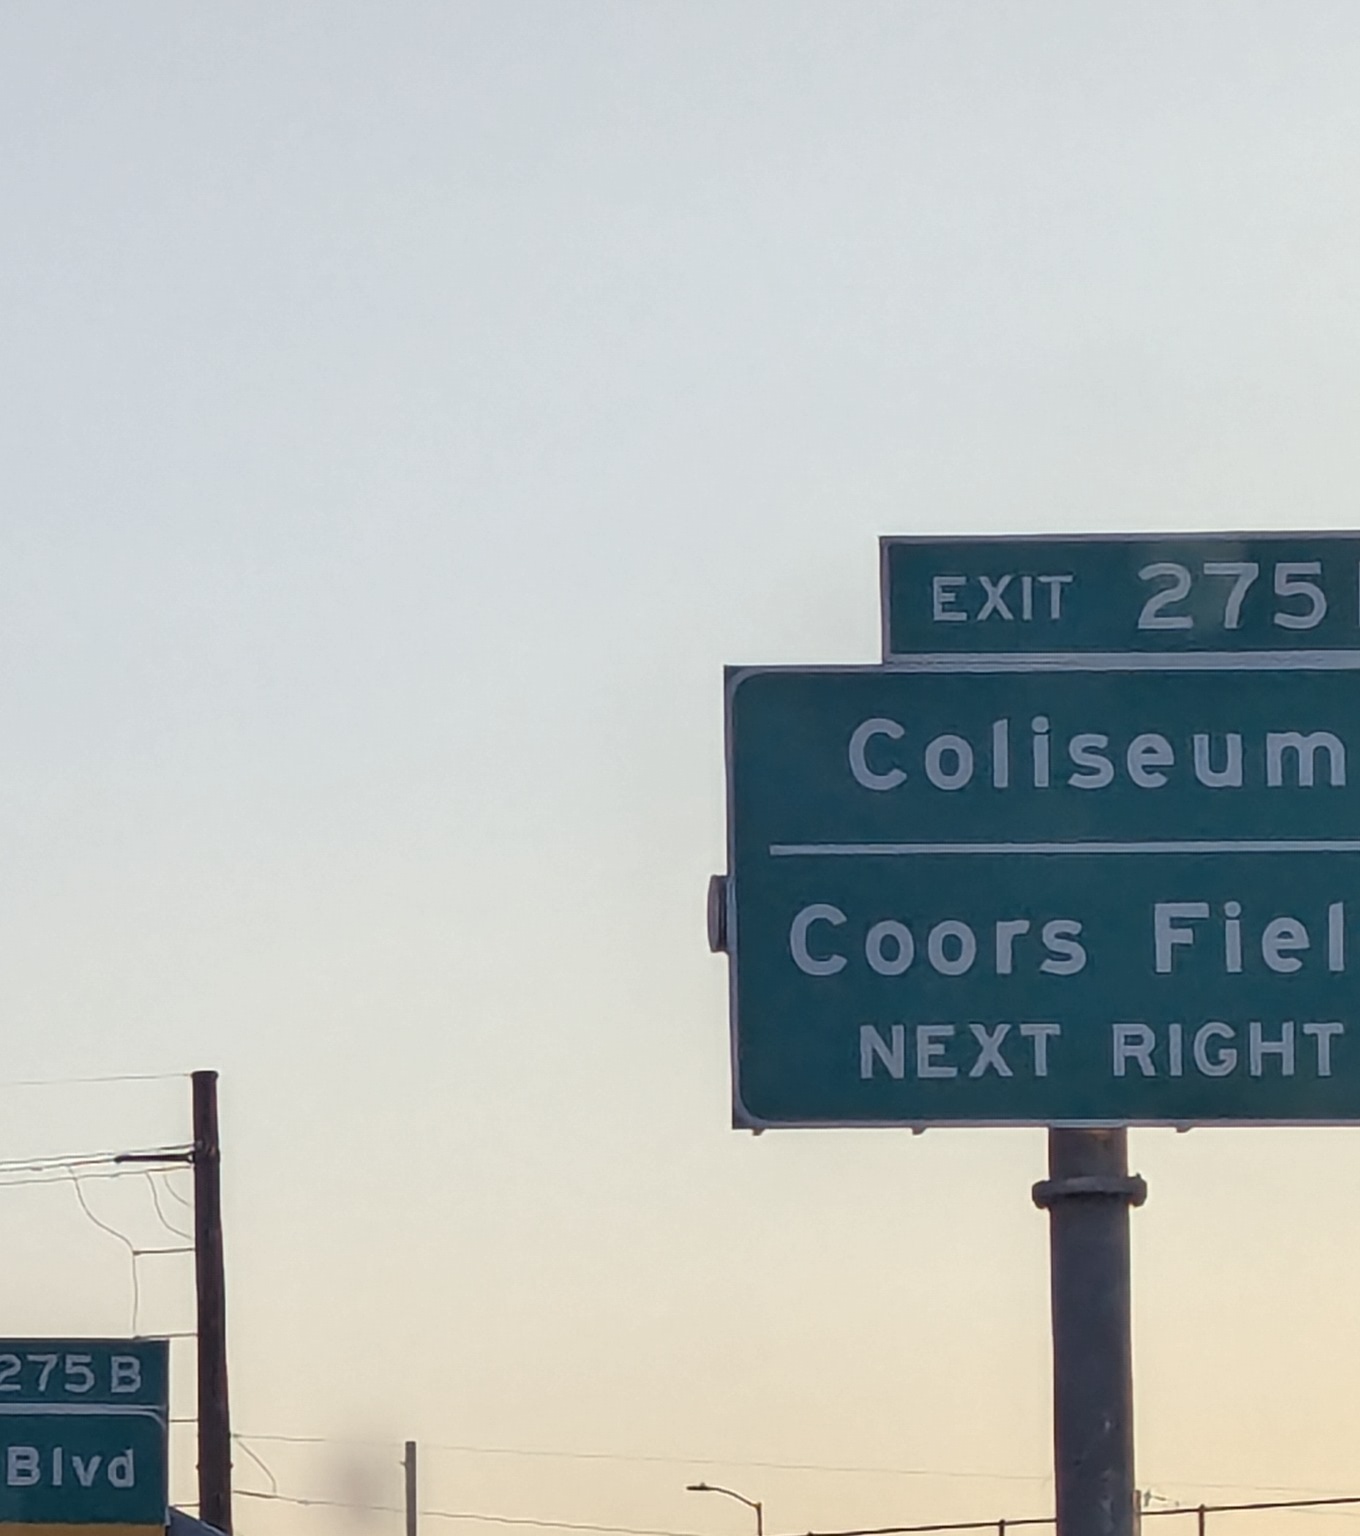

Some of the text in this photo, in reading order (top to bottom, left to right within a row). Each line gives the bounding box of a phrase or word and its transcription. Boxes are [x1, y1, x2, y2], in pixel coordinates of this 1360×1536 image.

[932, 562, 1360, 630] EXIT 275
[848, 715, 1346, 791] Coliseum
[789, 903, 1088, 976] Coors
[859, 1021, 1345, 1079] NEXT RIGHT
[6, 1445, 136, 1489] Blvd
